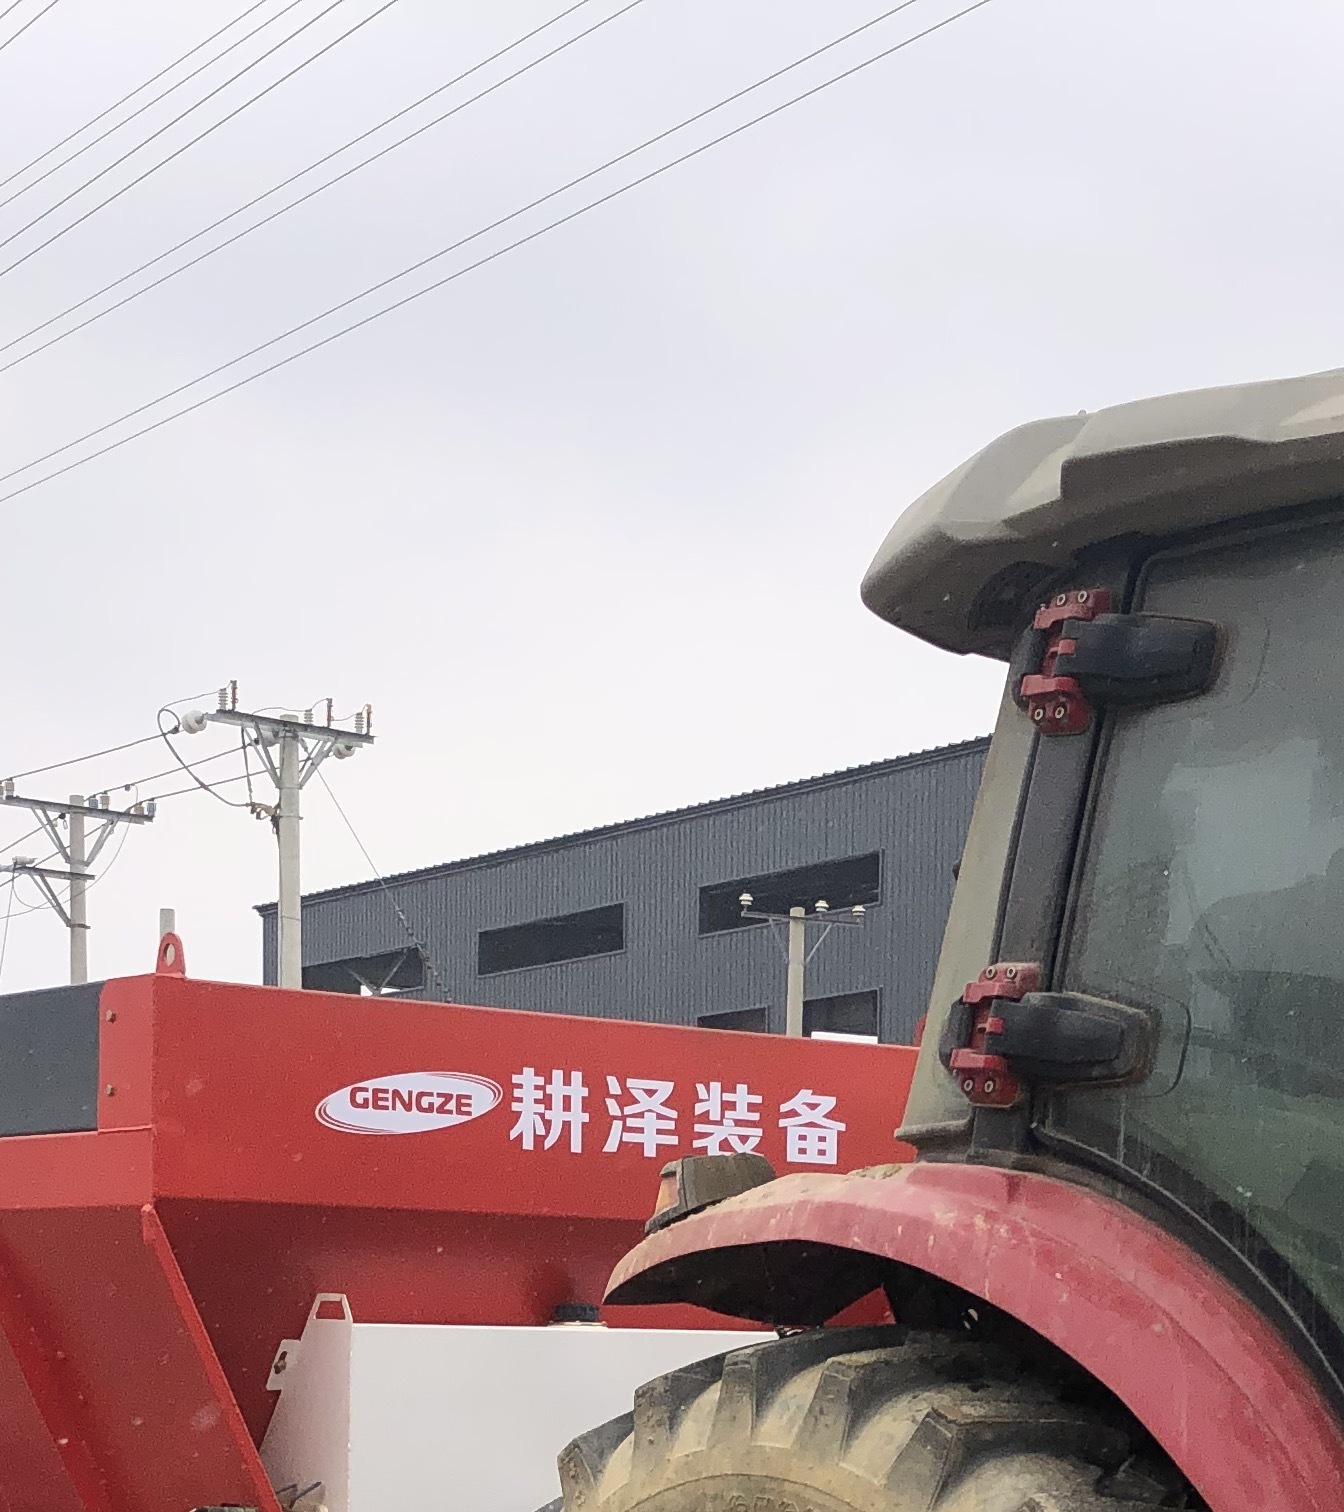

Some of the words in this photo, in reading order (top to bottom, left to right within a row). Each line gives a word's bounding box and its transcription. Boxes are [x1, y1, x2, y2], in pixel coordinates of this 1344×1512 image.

[349, 1086, 473, 1117] GENGZE
[509, 1066, 847, 1165] 耕泽装备
